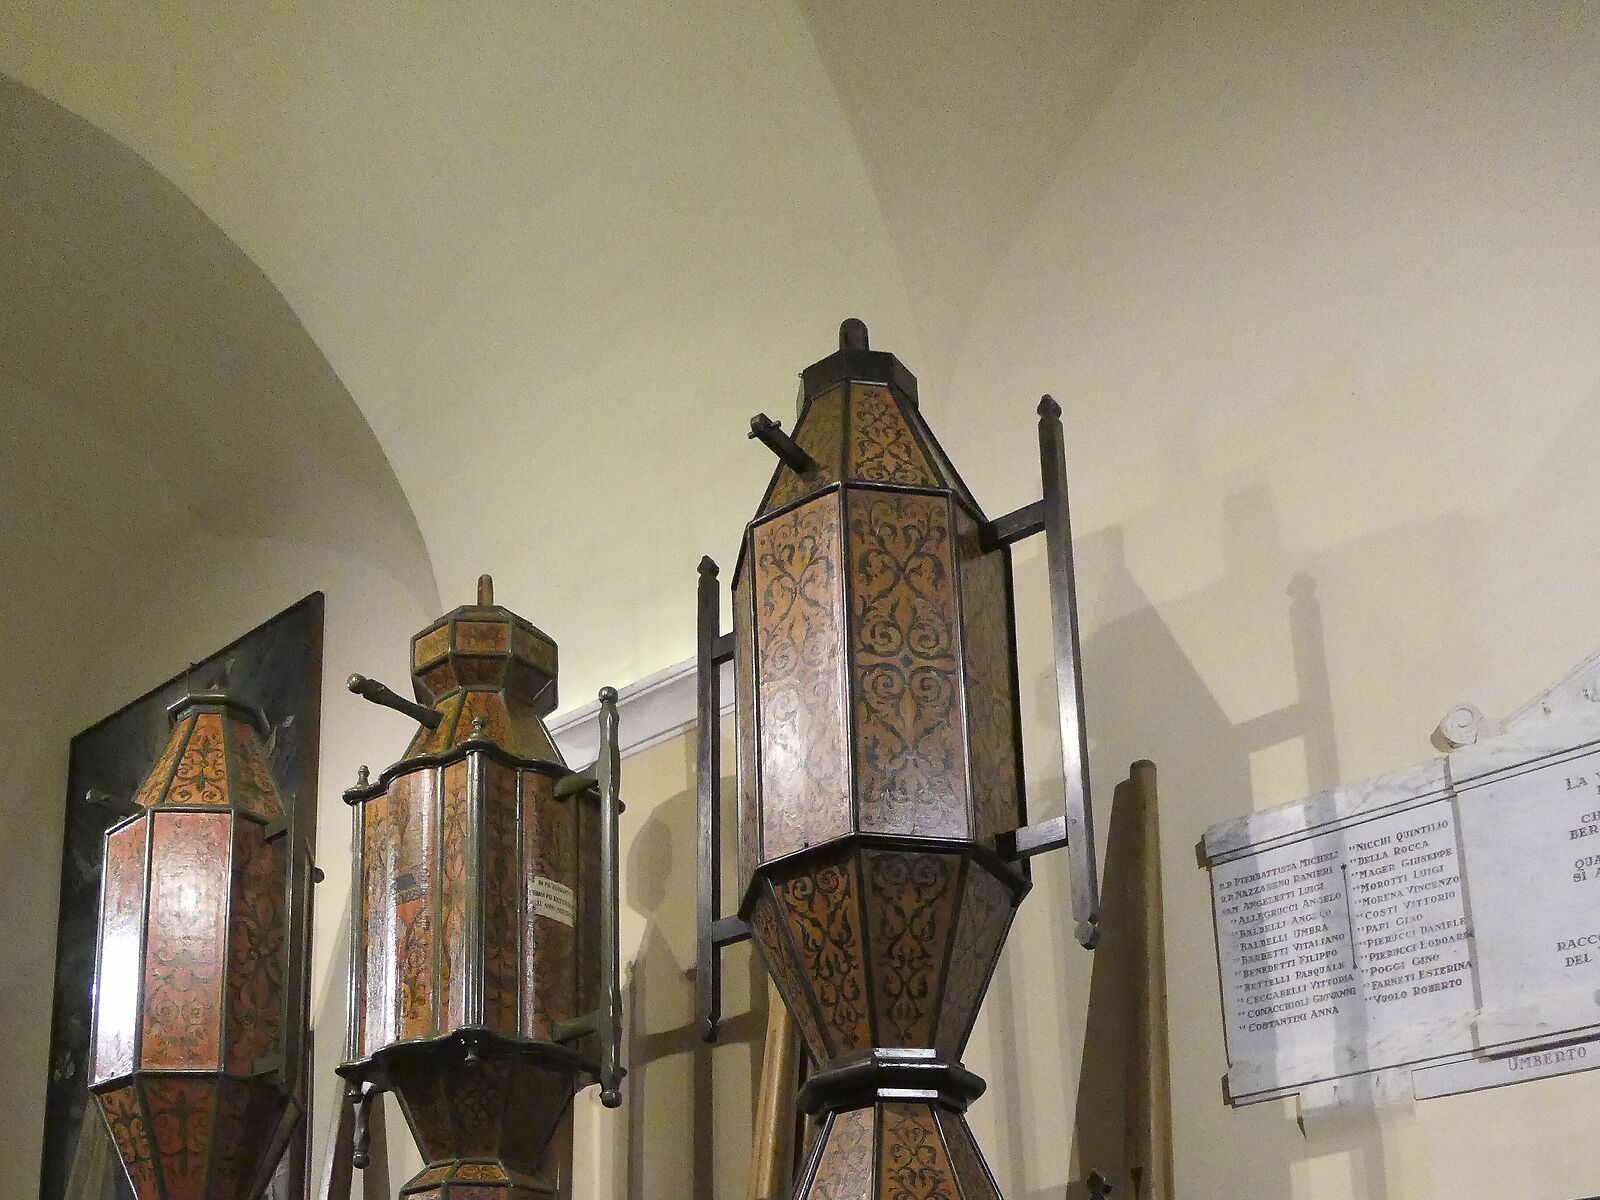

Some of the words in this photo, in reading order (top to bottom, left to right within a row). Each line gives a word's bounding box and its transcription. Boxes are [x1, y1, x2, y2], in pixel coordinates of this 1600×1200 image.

[1396, 820, 1449, 842] QUINTILIO
[1357, 851, 1388, 866] DELLA
[1393, 840, 1430, 856] ROCCA
[1359, 864, 1397, 879] MAGER
[1401, 848, 1452, 868] GIUSEPPE
[1293, 866, 1333, 884] RANIERI
[1360, 875, 1408, 893] MOROTTI
[1413, 865, 1444, 879] LUIGI
[1243, 890, 1295, 911] ANGELETTI
[1298, 883, 1325, 897] LUIGI
[1362, 890, 1404, 907] MORENA
[1406, 876, 1460, 895] VINCENZO
[1239, 904, 1299, 925] ALLEGRUCCI
[1365, 905, 1398, 920] COSTI
[1403, 891, 1456, 909] VITTORIO
[1240, 920, 1287, 938] BALDELLI
[1240, 934, 1288, 951] BALDELLI
[1294, 924, 1329, 938] UMBRA
[1365, 922, 1390, 934] PAPI
[1367, 930, 1416, 948] PIERUCCI
[1420, 917, 1466, 934] DANIELE
[1241, 947, 1289, 965] BARBETTI
[1292, 934, 1345, 951] VITALIANO
[1369, 944, 1417, 961] PIERUCCI
[1565, 953, 1593, 967] DEL
[1243, 959, 1296, 978] BENEDETTI
[1299, 949, 1338, 965] FILIPPO
[1295, 962, 1345, 980] PASQUALE
[1369, 962, 1406, 976] POGGI
[1412, 954, 1440, 966] GINO
[1419, 961, 1473, 979] ESTERINA
[1246, 984, 1307, 1005] CECCARELLI
[1310, 974, 1354, 990] VITTORIA
[1313, 987, 1357, 1003] GIOVANNI
[1412, 979, 1462, 996] ROBERTO
[1248, 1013, 1307, 1032] COSTANTINI
[1310, 1006, 1340, 1019] ANNA
[1508, 1047, 1587, 1071] UMBERTO
